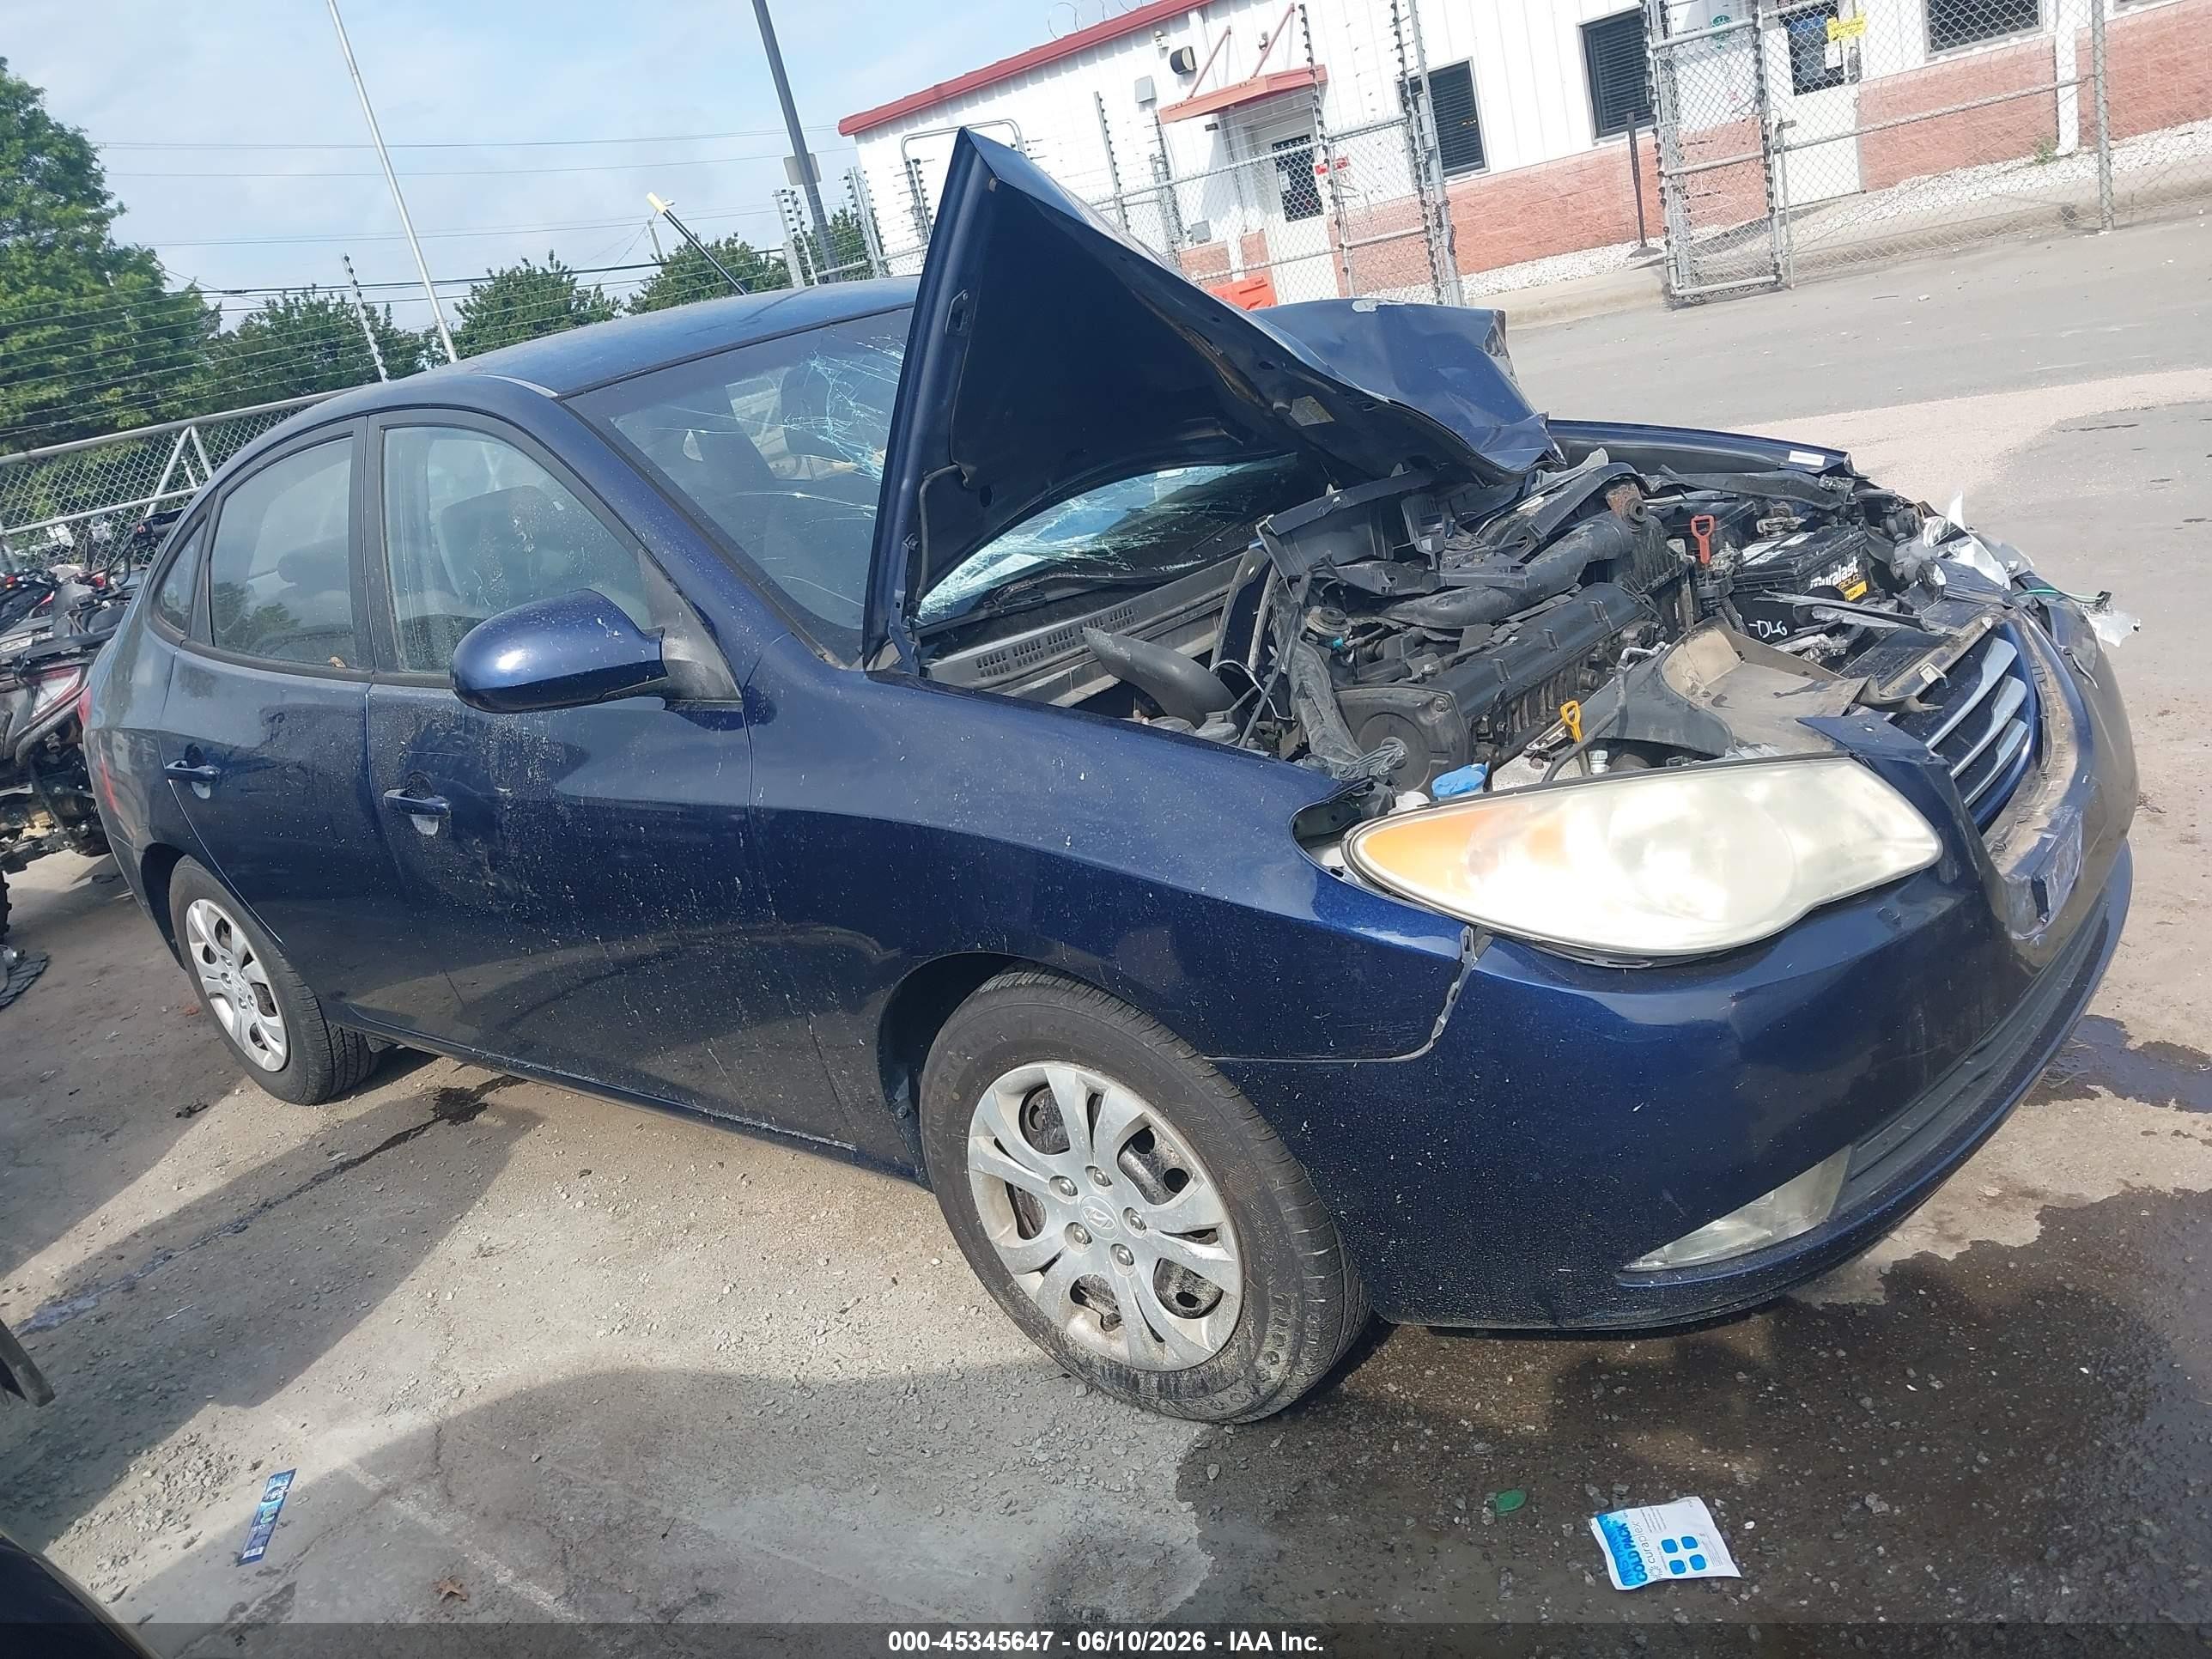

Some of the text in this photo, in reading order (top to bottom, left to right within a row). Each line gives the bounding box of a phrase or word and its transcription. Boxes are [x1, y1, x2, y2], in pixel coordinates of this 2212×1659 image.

[1615, 1522, 1648, 1582] COLD PACK
[1632, 1522, 1656, 1564] curaplex
